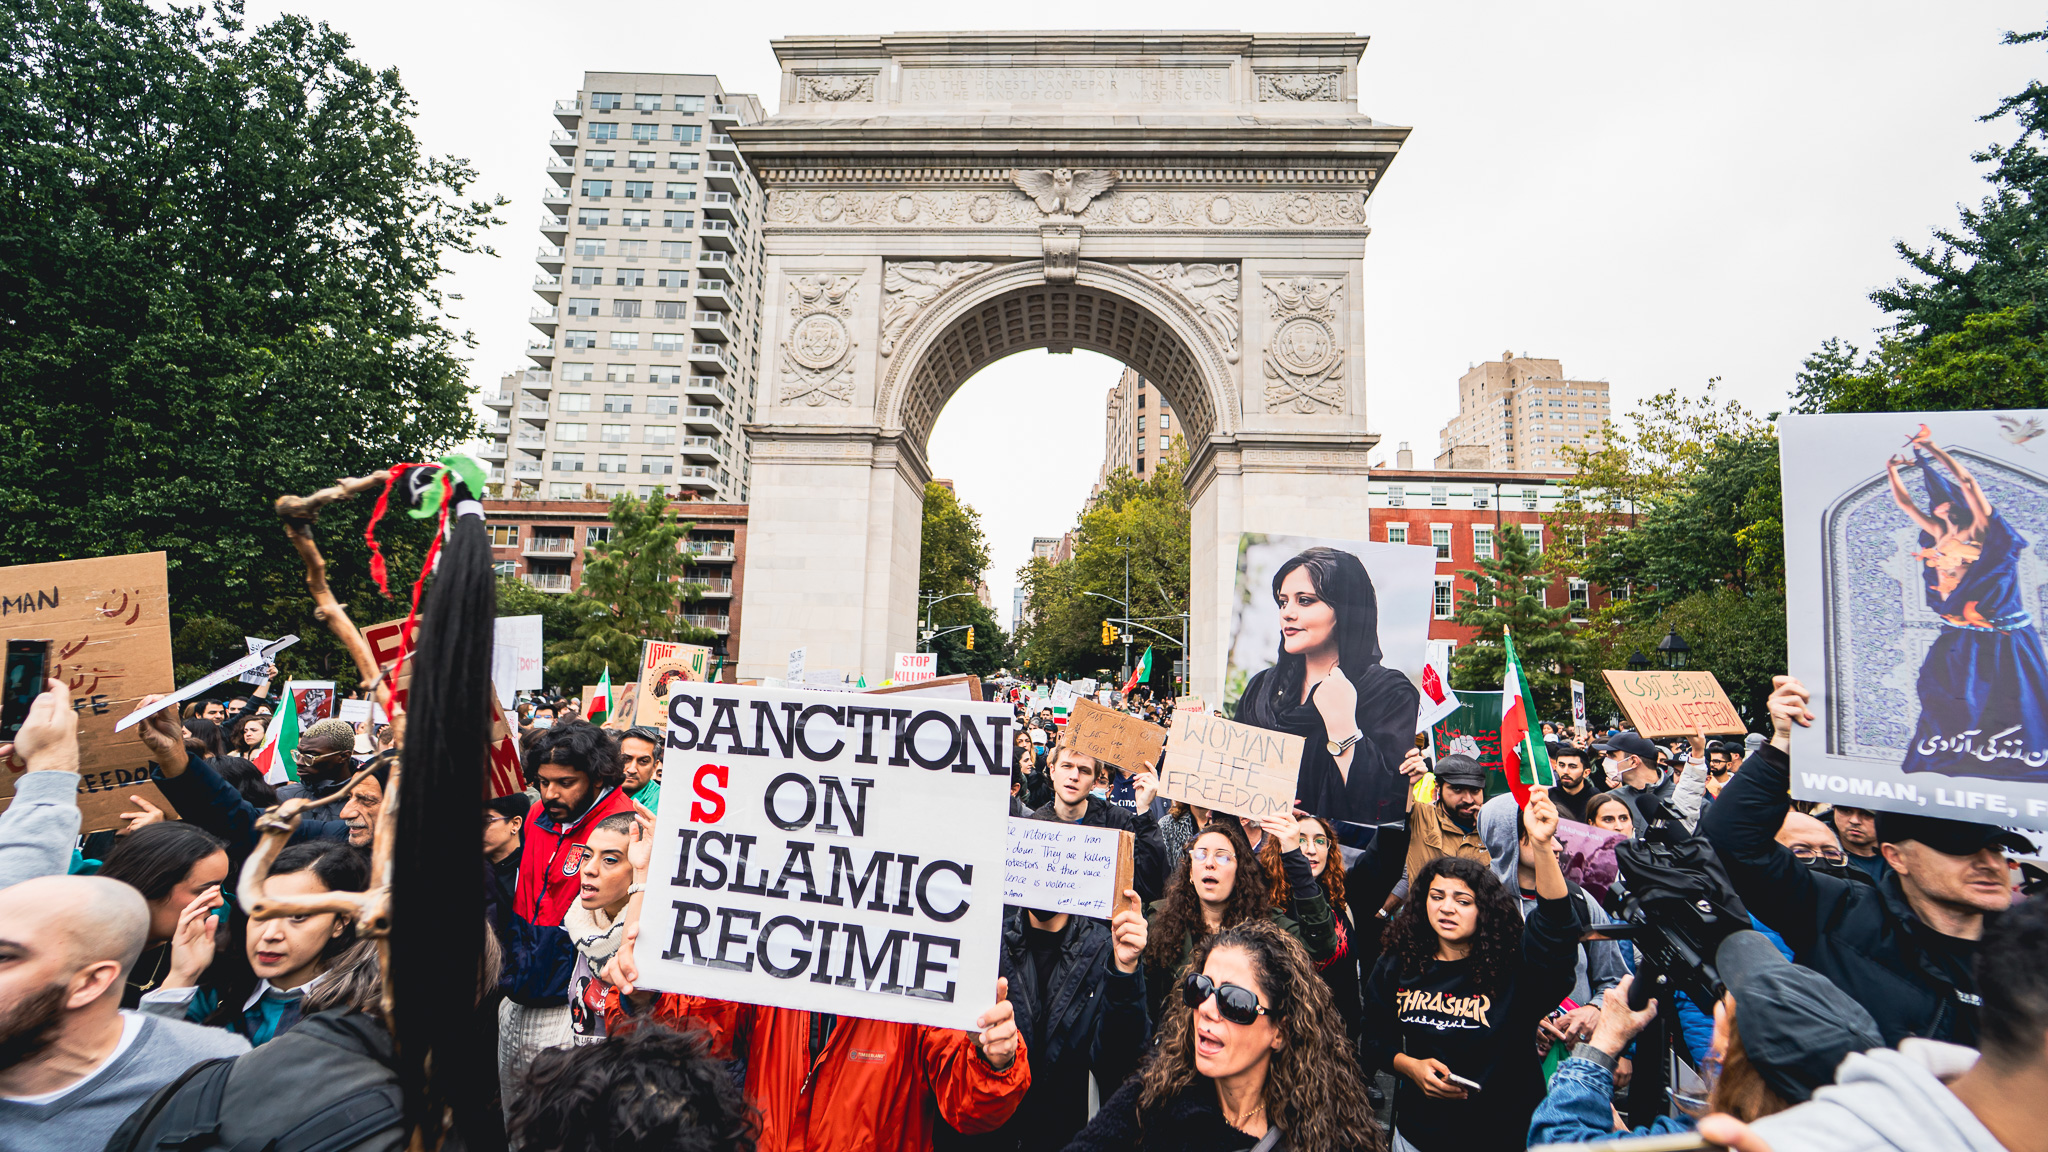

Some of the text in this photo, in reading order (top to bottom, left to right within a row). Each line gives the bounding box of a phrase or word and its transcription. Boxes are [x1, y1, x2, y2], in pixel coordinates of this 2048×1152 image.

[910, 80, 1222, 90] AND THE HONEST CAN REPAIR THE EVENT
[911, 70, 1222, 80] LET US RAISE A STANDARD TO WHICH THE WISE
[926, 91, 937, 100] IN
[943, 91, 969, 100] THE
[977, 91, 1014, 100] HAND
[1020, 91, 1037, 100] OF
[1044, 91, 1073, 100] GOD
[1129, 91, 1222, 100] WASHINGTON
[0, 586, 59, 617] MAN
[902, 655, 930, 667] STOP
[73, 694, 111, 716] FE
[665, 693, 1012, 776] SANCTION
[1184, 715, 1286, 764] WOMAN
[77, 761, 152, 795] EEDO
[1197, 749, 1265, 789] LIFE
[689, 763, 875, 838] S ON
[1167, 771, 1288, 816] FREEDOM
[1801, 772, 2048, 818] WOMAN, LIFE, F
[1041, 845, 1061, 865] They
[1046, 863, 1057, 873] Be
[670, 828, 974, 924] ISLAMIC
[1005, 872, 1027, 885] lence
[661, 900, 961, 1004] REGIME
